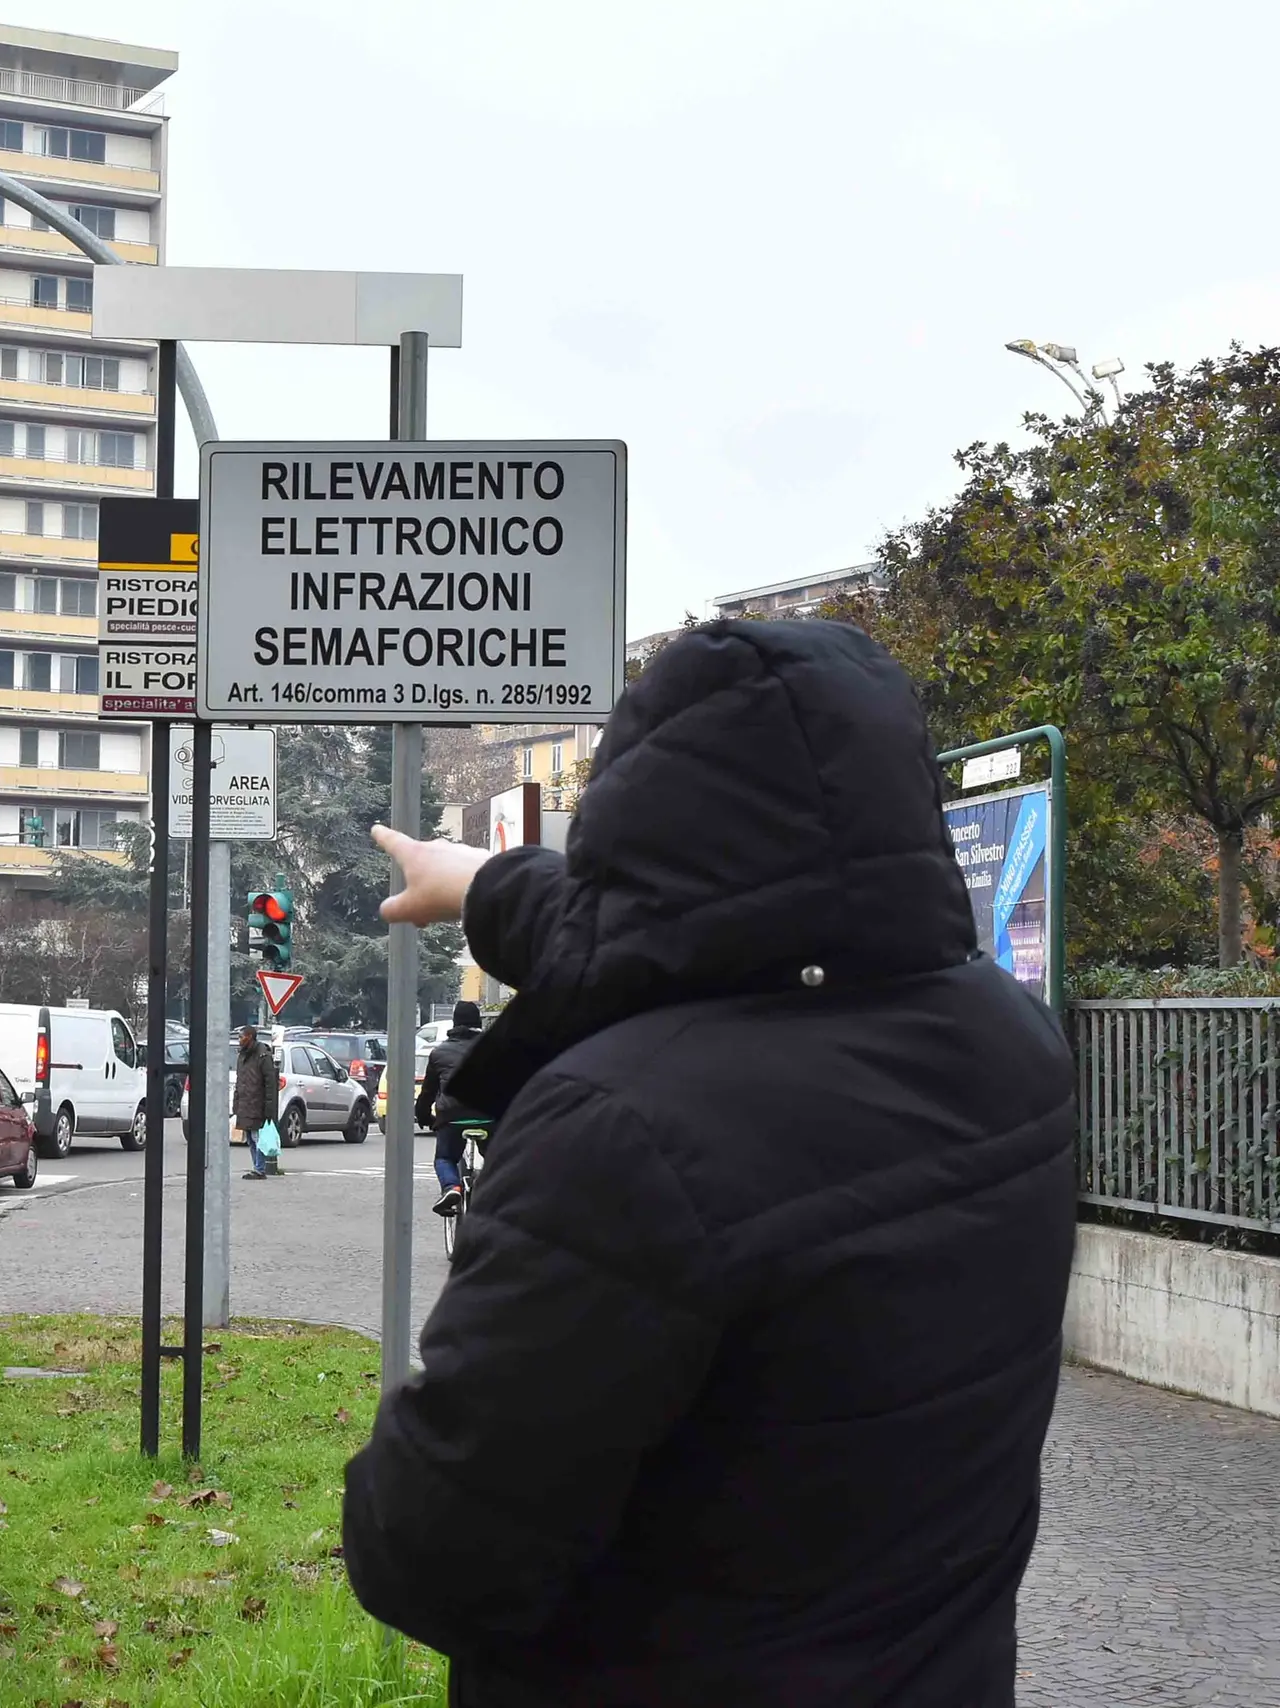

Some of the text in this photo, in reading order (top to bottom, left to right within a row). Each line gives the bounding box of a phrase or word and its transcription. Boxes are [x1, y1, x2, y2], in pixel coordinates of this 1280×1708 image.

[261, 461, 565, 501] RILEVAMENTO
[260, 515, 564, 556] ELETTRONICO
[289, 571, 532, 612] INFRAZIONI
[253, 626, 567, 668] SEMAFORICHE
[106, 671, 132, 689] IL
[228, 682, 592, 709] Art. 146/comma 3 D.lgs. n. 285/1992
[229, 776, 271, 790] AREA
[172, 794, 270, 806] VIDEORVEGLIATA
[955, 843, 1005, 867] San Silvestro
[972, 870, 992, 888] Emilia
